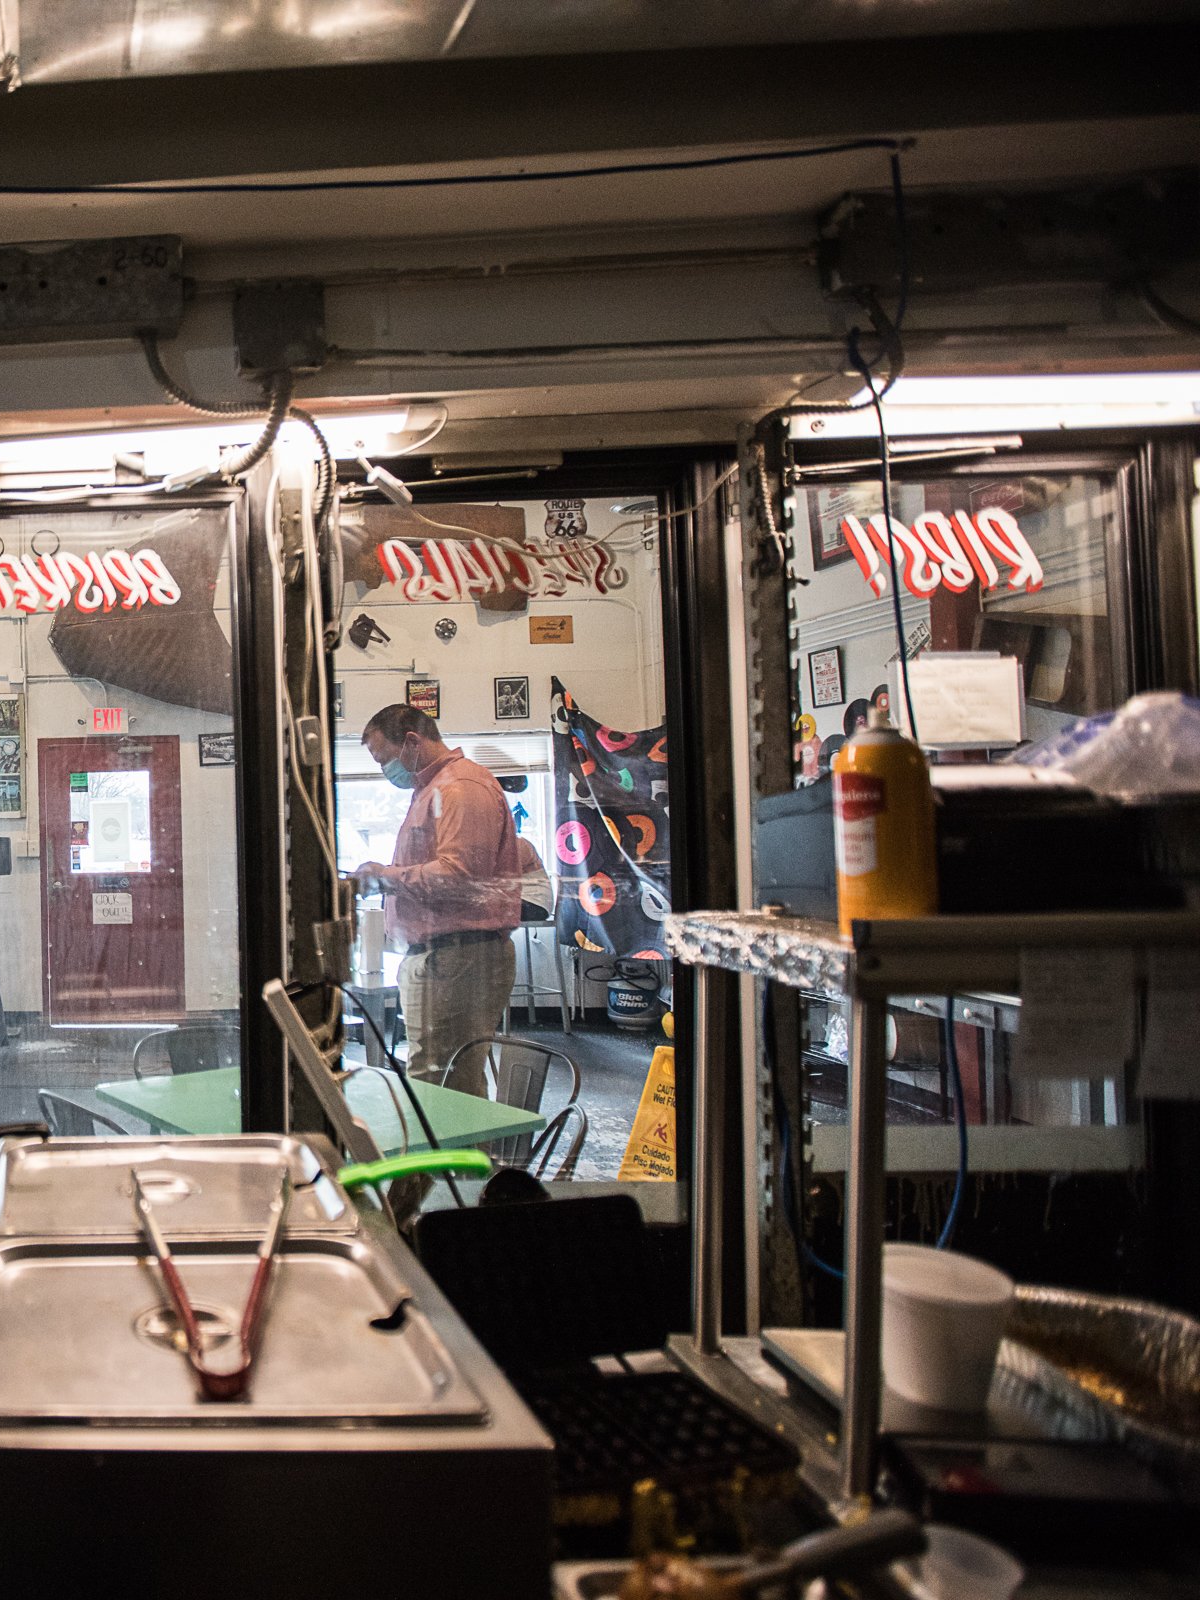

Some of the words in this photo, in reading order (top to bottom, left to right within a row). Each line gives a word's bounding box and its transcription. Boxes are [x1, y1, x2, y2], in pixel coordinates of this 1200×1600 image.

[554, 520, 579, 537] 66
[93, 708, 122, 731] EXIT
[618, 993, 643, 1001] Blue
[653, 1093, 666, 1105] Wet
[642, 1145, 670, 1163] Cuidado
[633, 1155, 648, 1168] Piso
[649, 1159, 674, 1177] Mojado
